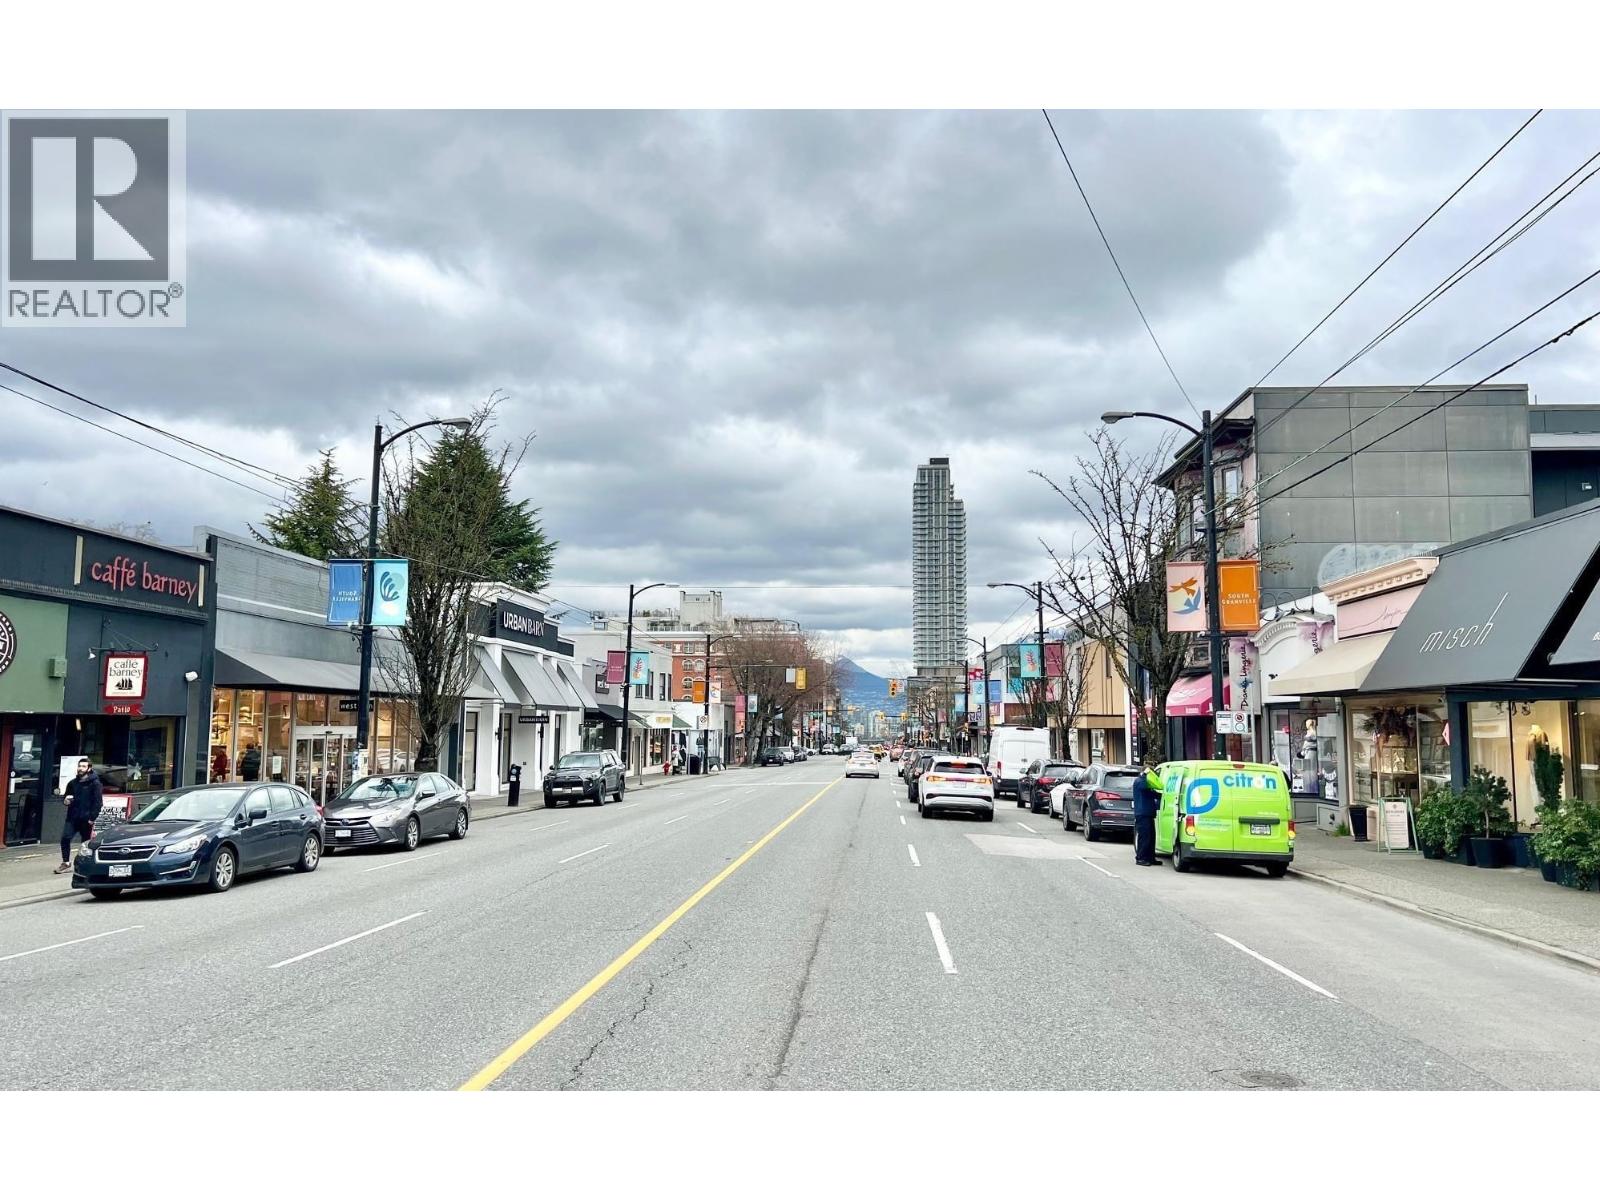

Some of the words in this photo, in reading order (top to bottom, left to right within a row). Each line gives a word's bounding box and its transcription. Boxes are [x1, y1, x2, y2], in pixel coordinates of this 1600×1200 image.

[91, 555, 137, 592] caffé
[142, 561, 197, 604] barney
[503, 611, 527, 633] URBAN
[527, 618, 544, 637] BARN
[1420, 592, 1509, 653] misch
[109, 667, 143, 679] barney
